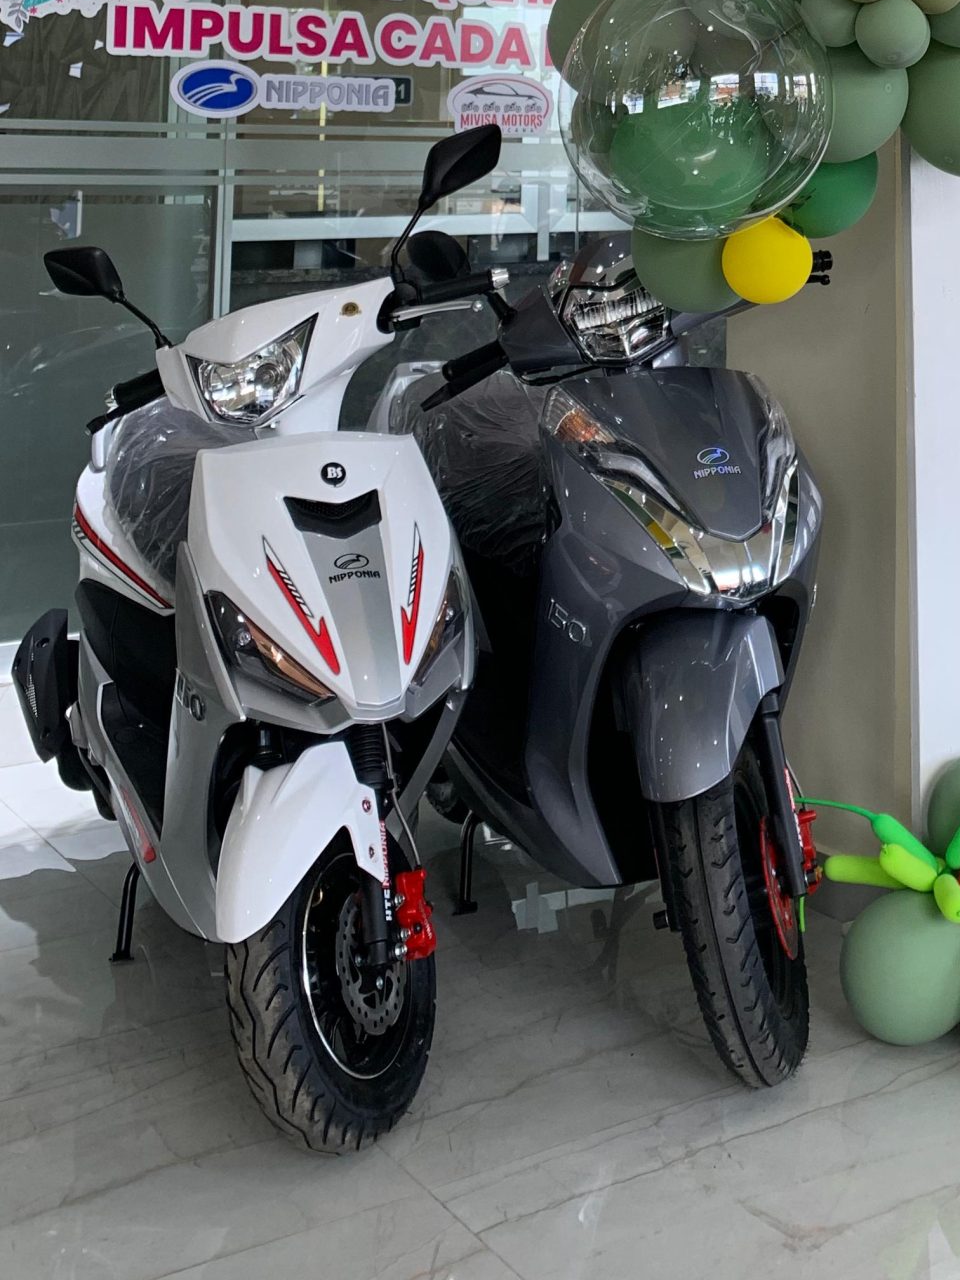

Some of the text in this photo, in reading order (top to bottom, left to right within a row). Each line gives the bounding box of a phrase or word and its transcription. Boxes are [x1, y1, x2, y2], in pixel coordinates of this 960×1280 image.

[113, 5, 368, 58] IMPULSA
[380, 20, 531, 66] CADA
[266, 80, 389, 106] NIPPONIA
[501, 113, 543, 129] MOTORS
[693, 465, 741, 479] NIPPONIA
[328, 570, 381, 584] NIPPONIA
